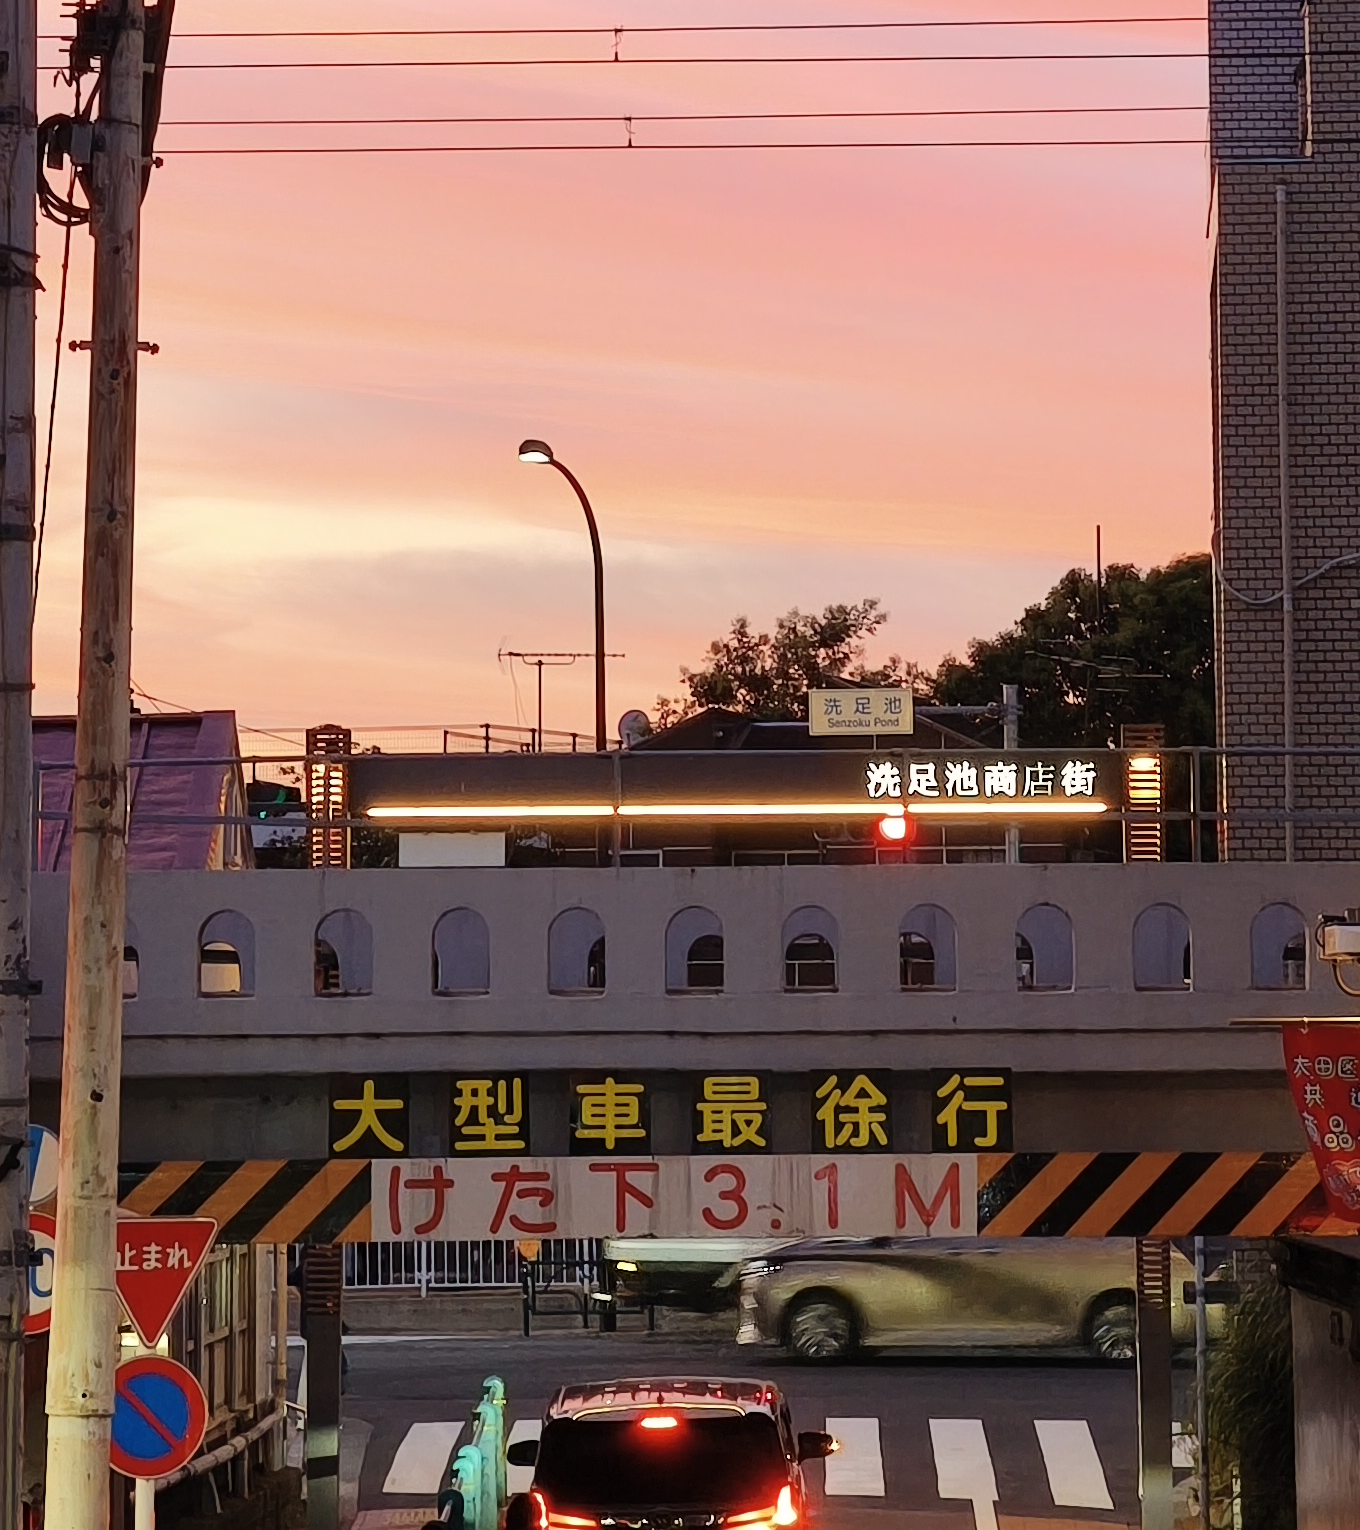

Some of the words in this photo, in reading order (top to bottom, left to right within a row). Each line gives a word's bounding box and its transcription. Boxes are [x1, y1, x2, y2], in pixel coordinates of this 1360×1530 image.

[823, 695, 904, 716] 洗足池
[827, 717, 871, 728] Senzoku
[873, 716, 900, 728] Pond
[866, 760, 1098, 799] 洗足池商店街
[331, 1073, 1010, 1152] 大型車最徐行
[116, 1241, 193, 1271] 止まれ
